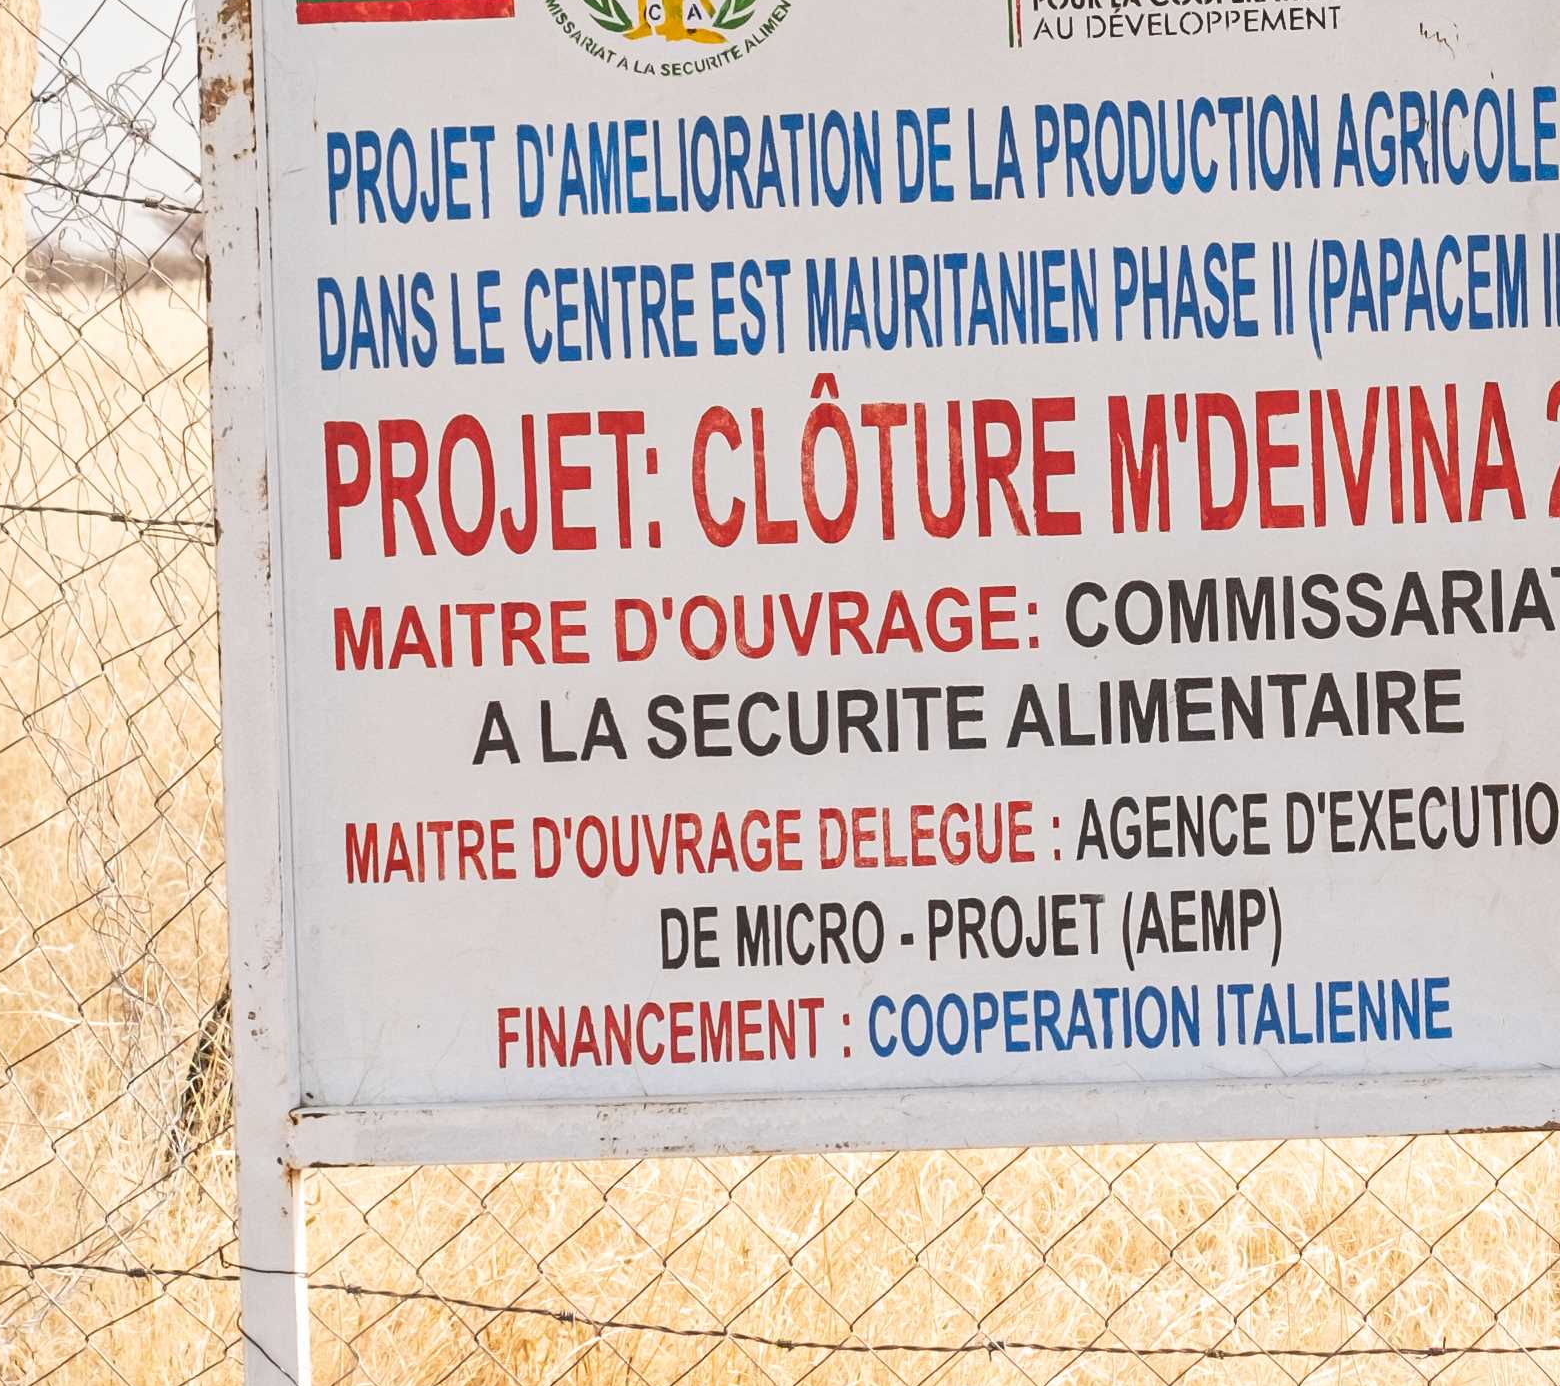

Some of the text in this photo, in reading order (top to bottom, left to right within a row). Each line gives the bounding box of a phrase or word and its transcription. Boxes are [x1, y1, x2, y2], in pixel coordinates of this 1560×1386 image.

[616, 55, 629, 70] A
[633, 59, 656, 76] LA
[660, 44, 743, 77] SECURITE
[1033, 5, 1341, 41] AU DÉVELOPPEMENT
[326, 85, 1560, 226] PROJET D'AMELIORATION DE LA PRODUCTION AGRICOLE
[317, 271, 438, 372] DANS
[450, 269, 505, 366] LE
[523, 263, 698, 365] CENTRE
[710, 258, 792, 357] EST
[805, 247, 1099, 352] MAURITANIEN
[1112, 241, 1259, 342] PHASE
[1272, 241, 1295, 337] II
[1308, 233, 1529, 361] (PAPACEM
[323, 410, 662, 561] PROJET:
[691, 372, 1083, 548] CLÔTURE
[1107, 381, 1527, 534] M'DEIVINA
[333, 600, 591, 672] MAITRE
[614, 585, 1040, 663] D'OUVRAGE:
[471, 668, 1465, 766] A LA SECURITE ALIMENTAIRE
[345, 818, 517, 885] MAITRE
[532, 809, 803, 879] D'OUVRAGE
[1076, 792, 1271, 861] AGENCE
[660, 906, 721, 970] DE
[735, 900, 885, 967] MICRO
[927, 893, 1106, 962] PROJET
[1122, 886, 1282, 972] (AEMP)
[497, 997, 825, 1069] FINANCEMENT
[868, 984, 1201, 1058] COOPERATION
[1216, 976, 1453, 1047] ITALIENNE
